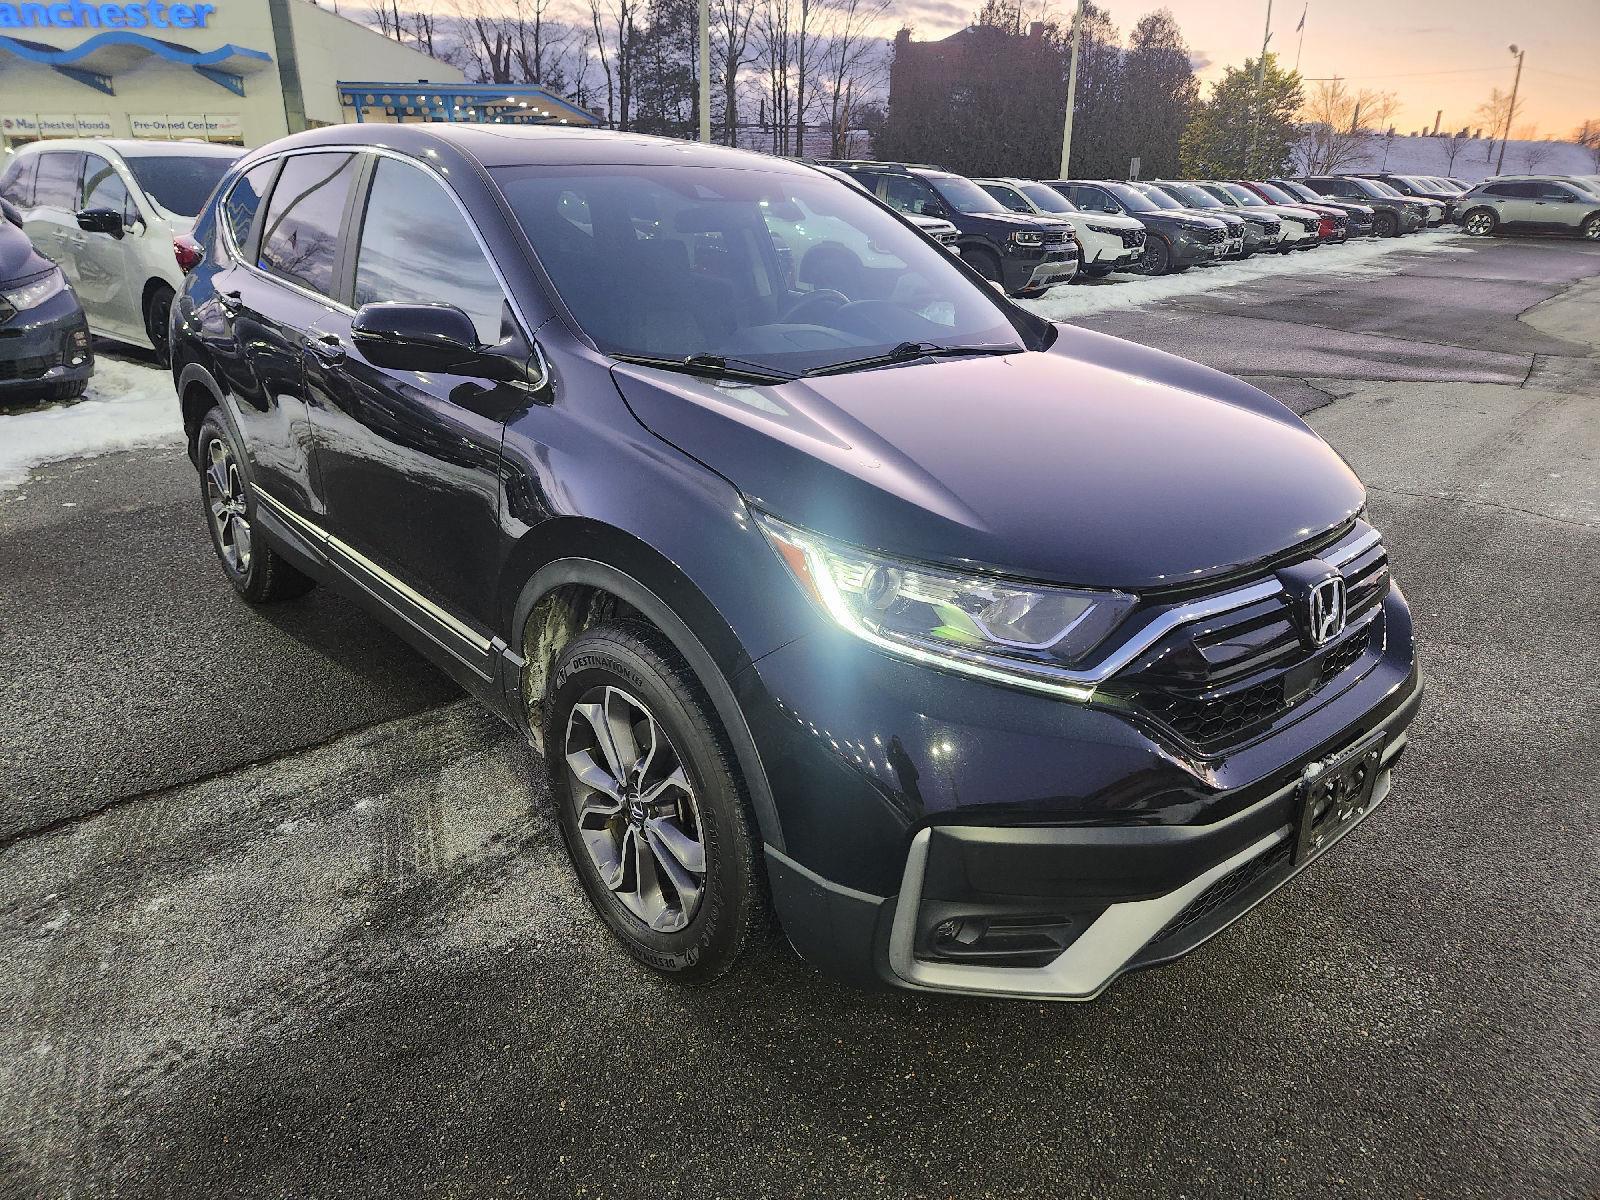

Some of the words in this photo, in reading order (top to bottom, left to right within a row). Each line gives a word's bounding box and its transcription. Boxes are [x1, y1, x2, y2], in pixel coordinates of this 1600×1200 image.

[0, 0, 214, 28] anchester
[78, 119, 110, 129] Honda
[133, 121, 185, 129] Pre-Owned
[187, 121, 218, 129] Center
[573, 655, 631, 679] DESTINATION
